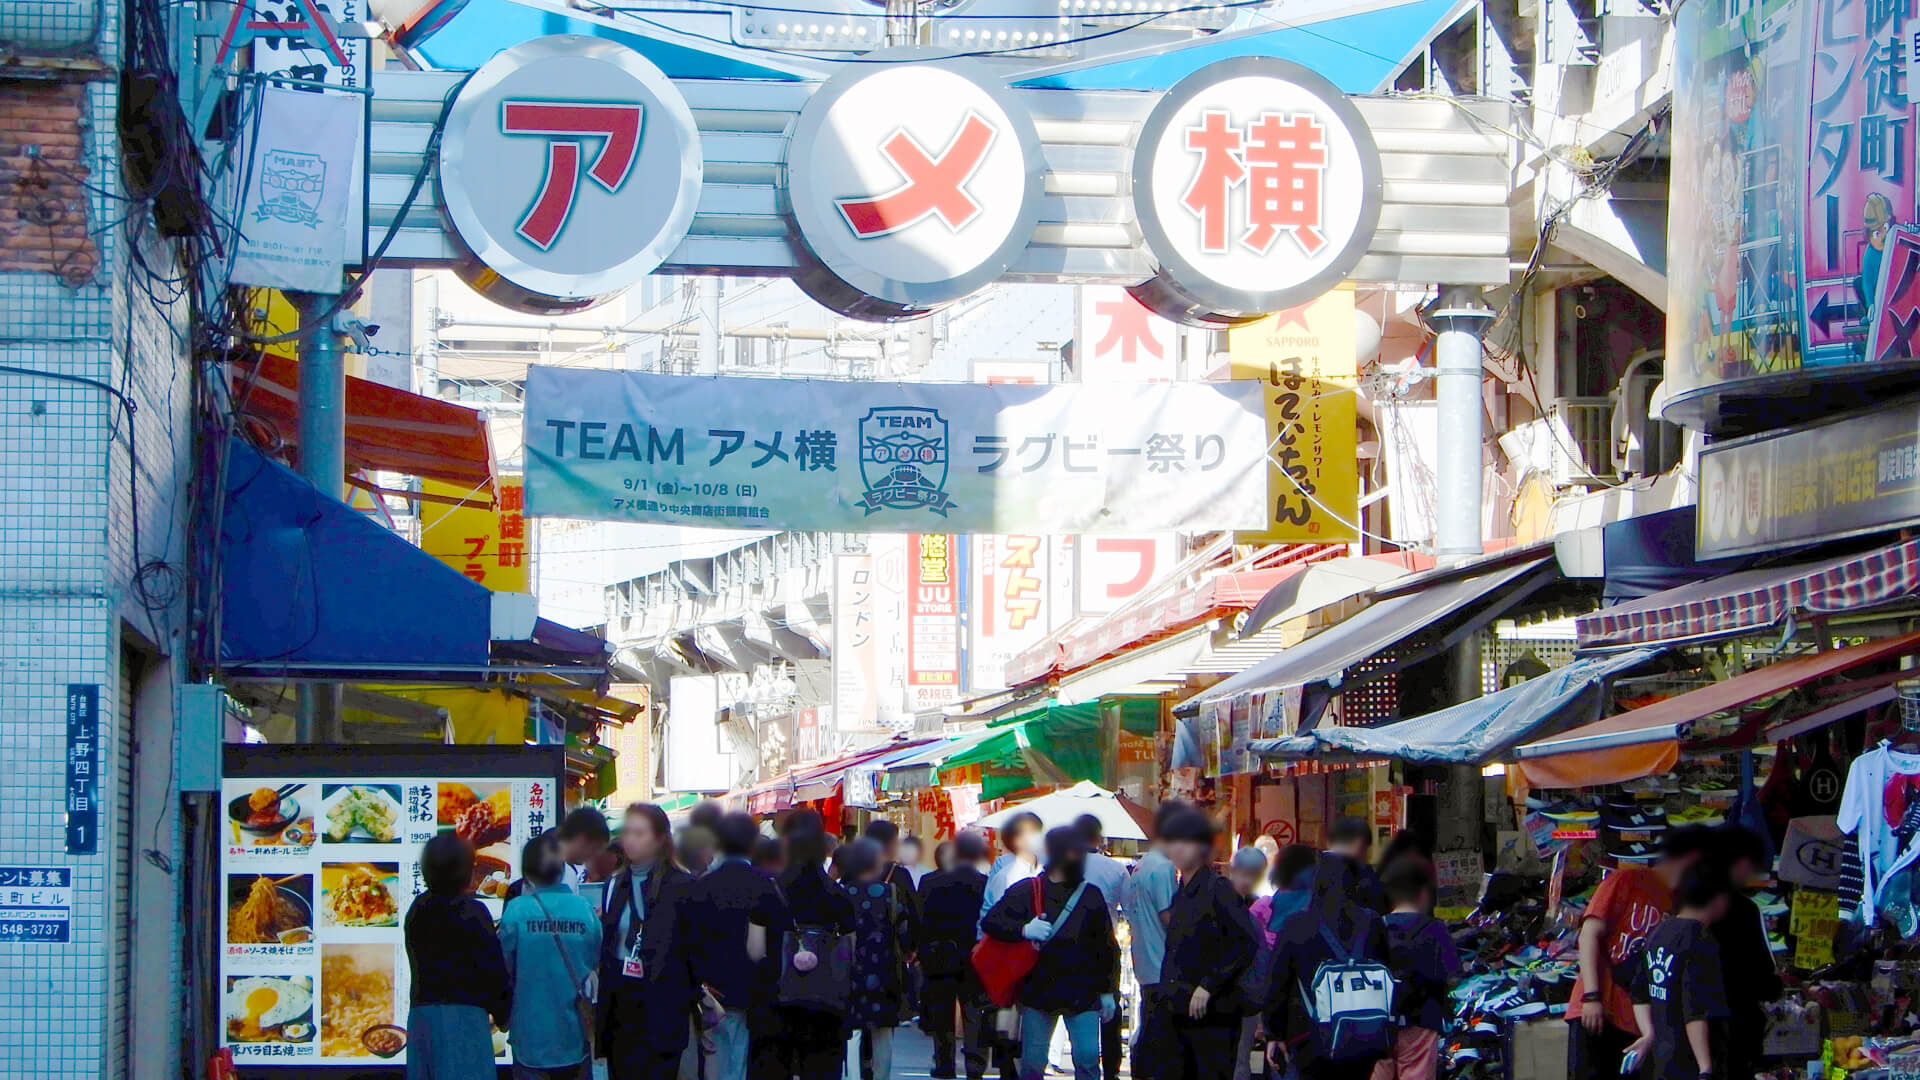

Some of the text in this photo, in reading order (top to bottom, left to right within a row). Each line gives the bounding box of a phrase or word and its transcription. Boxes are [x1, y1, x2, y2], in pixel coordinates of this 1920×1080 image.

[1265, 336, 1320, 347] SAPPORO
[876, 416, 932, 429] TEAM
[546, 418, 838, 472] TEAM アメ横
[972, 432, 1226, 475] ラグビー祭り
[1269, 356, 1317, 527] ほていちゃん
[498, 485, 525, 568] 御徒町
[918, 587, 950, 603] UU
[1000, 534, 1041, 629] ストア
[853, 570, 871, 648] ロンドン
[917, 603, 953, 613] STORE
[75, 723, 90, 845] 上野四丁目 1
[529, 782, 544, 808] 名物
[420, 785, 433, 821] ちくわ
[0, 870, 62, 886] ント募集
[0, 923, 60, 935] 548-3737
